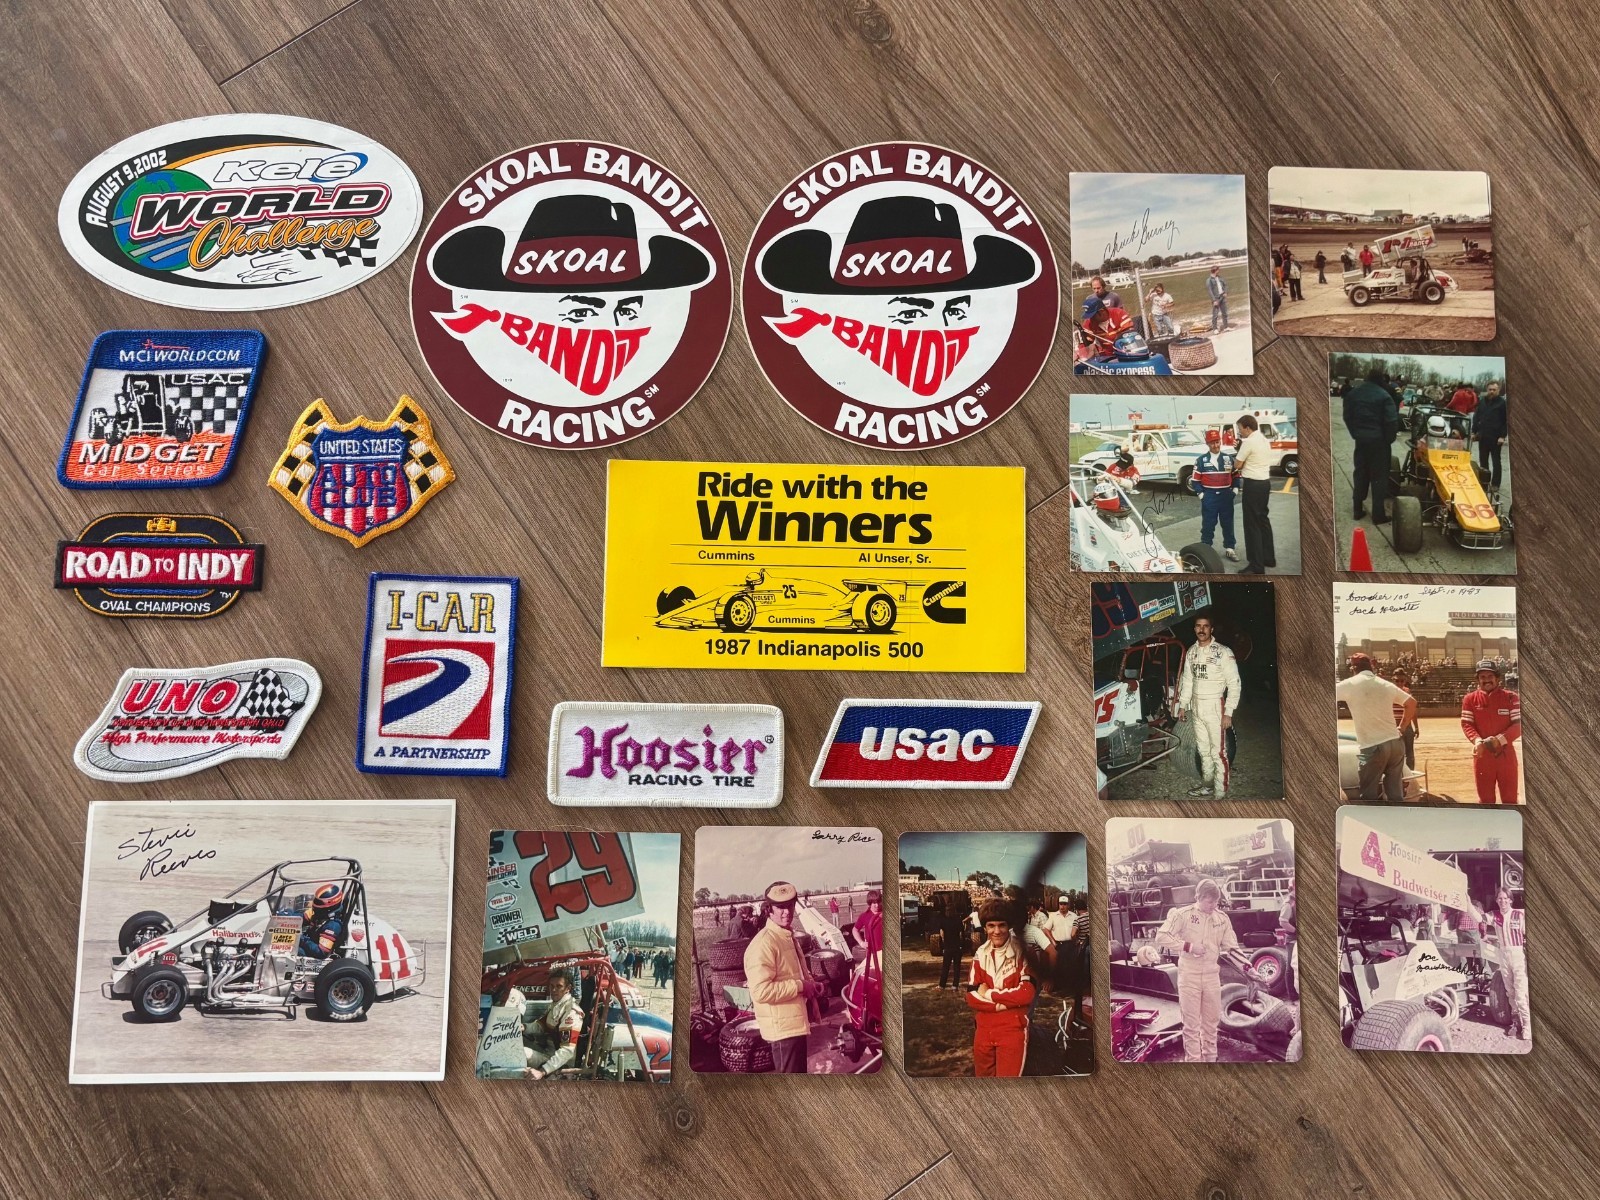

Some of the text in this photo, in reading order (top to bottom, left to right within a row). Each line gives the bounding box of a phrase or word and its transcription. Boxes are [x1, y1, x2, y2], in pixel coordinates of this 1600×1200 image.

[213, 157, 358, 184] Kele
[85, 173, 126, 228] AUGUST
[458, 147, 709, 232] SKOAL BANDIT
[782, 148, 1033, 231] SKOAL BANDIT
[132, 184, 390, 235] WORLD
[188, 215, 381, 271] Challenge
[513, 248, 627, 275] SKOAL
[841, 249, 952, 278] SKOAL
[500, 312, 651, 396] BANDIT
[831, 316, 981, 397] BANDIT
[170, 373, 245, 385] USAC
[498, 398, 656, 444] RACING
[834, 395, 989, 445] RACING
[78, 442, 223, 464] MIDGET
[319, 438, 404, 455] UNITED STATES
[84, 462, 207, 477] Car Series
[321, 465, 397, 488] AUTO
[321, 487, 396, 508] CLUB
[698, 472, 928, 501] Ride with the
[696, 500, 933, 544] Winners
[1457, 503, 1495, 519] 66
[65, 550, 250, 581] ROAD TO INDY
[698, 549, 755, 562] Cummins
[858, 552, 932, 565] Al Unser, Sr.
[782, 584, 797, 599] 25
[923, 580, 964, 607] Cummins
[100, 600, 211, 612] OVAL CHAMPIONS
[387, 590, 496, 633] I-CAR
[768, 615, 816, 625] Cummins
[705, 639, 924, 660] 1987 Indianapolis 500
[120, 678, 242, 716] UNO
[101, 732, 282, 746] High Performance Motorsports
[566, 722, 767, 779] Hoosier
[859, 727, 995, 762] usac
[374, 746, 491, 760] A PARTNERSHIP
[628, 774, 755, 787] RACING TIRE
[1360, 831, 1386, 877] 4
[1393, 869, 1447, 902] Budweiser
[492, 910, 521, 925] CROWER
[507, 927, 538, 941] WELD
[375, 933, 411, 980] 11
[492, 1016, 519, 1031] Fred
[484, 1029, 521, 1050] Grenoble
